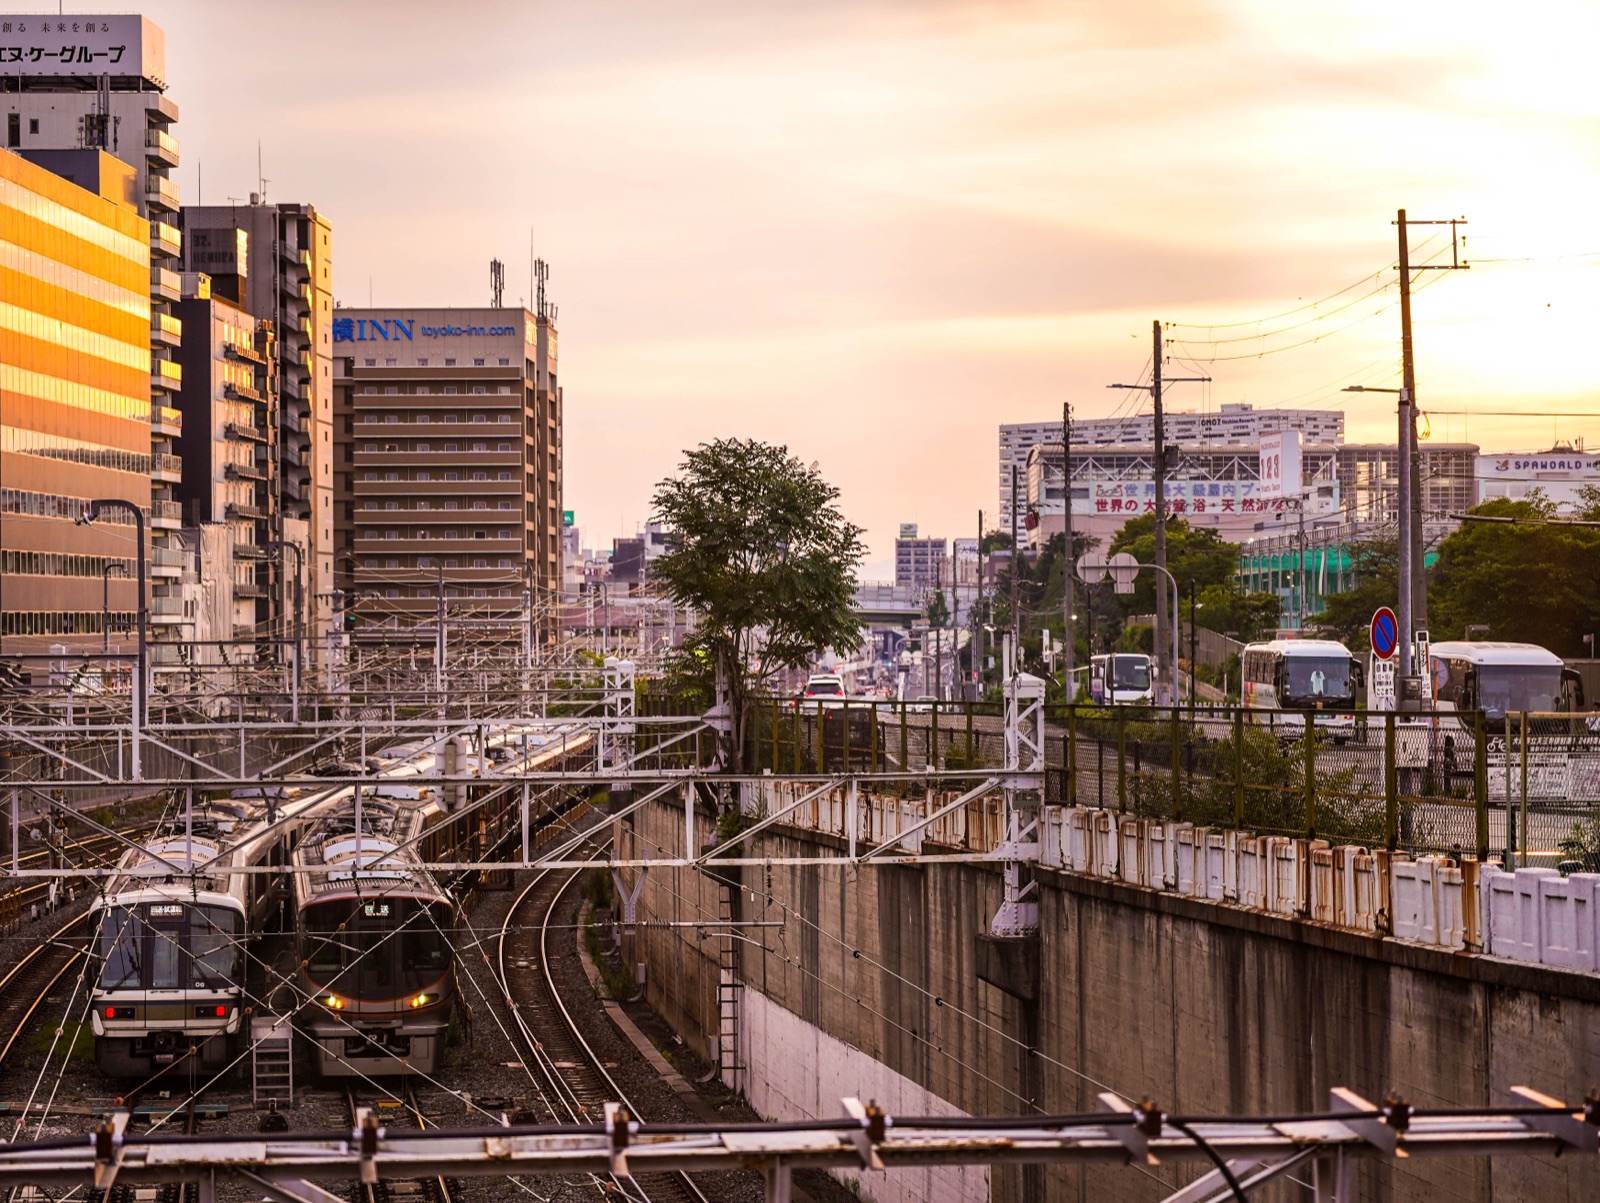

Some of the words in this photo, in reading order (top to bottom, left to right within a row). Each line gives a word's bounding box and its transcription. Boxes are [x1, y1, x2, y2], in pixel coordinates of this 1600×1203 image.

[2, 23, 26, 33] 創る
[41, 22, 109, 33] 未来を創る
[421, 325, 516, 339] toyoko-inn.com
[1514, 461, 1582, 470] SPAWORLD
